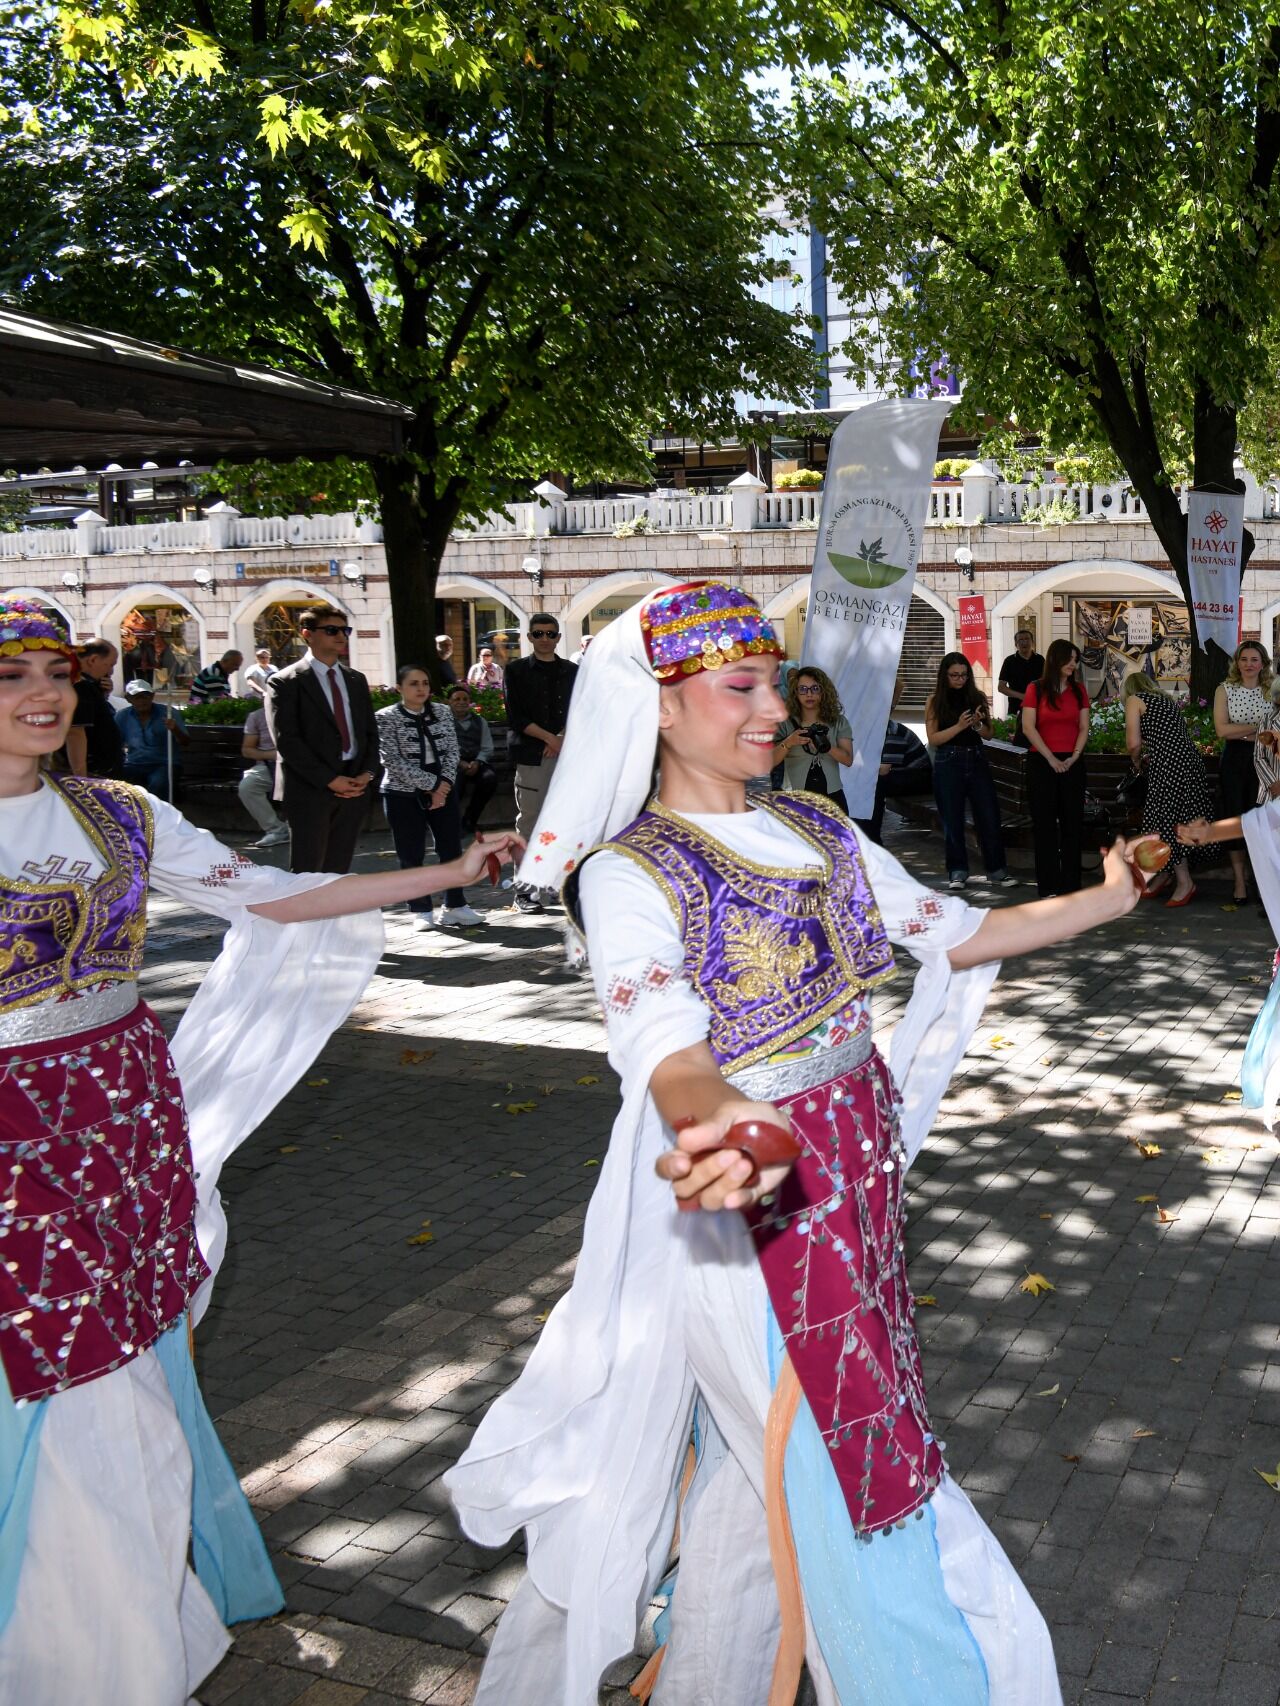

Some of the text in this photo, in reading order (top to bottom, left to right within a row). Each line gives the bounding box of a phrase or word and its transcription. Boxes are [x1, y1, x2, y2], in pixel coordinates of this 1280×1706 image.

[825, 520, 838, 547] BURSA
[1191, 537, 1239, 554] HAYAT
[1191, 555, 1237, 567] HASTANESİ
[1209, 603, 1220, 613] 23
[1222, 604, 1234, 614] 64
[961, 613, 983, 621] HAYAT
